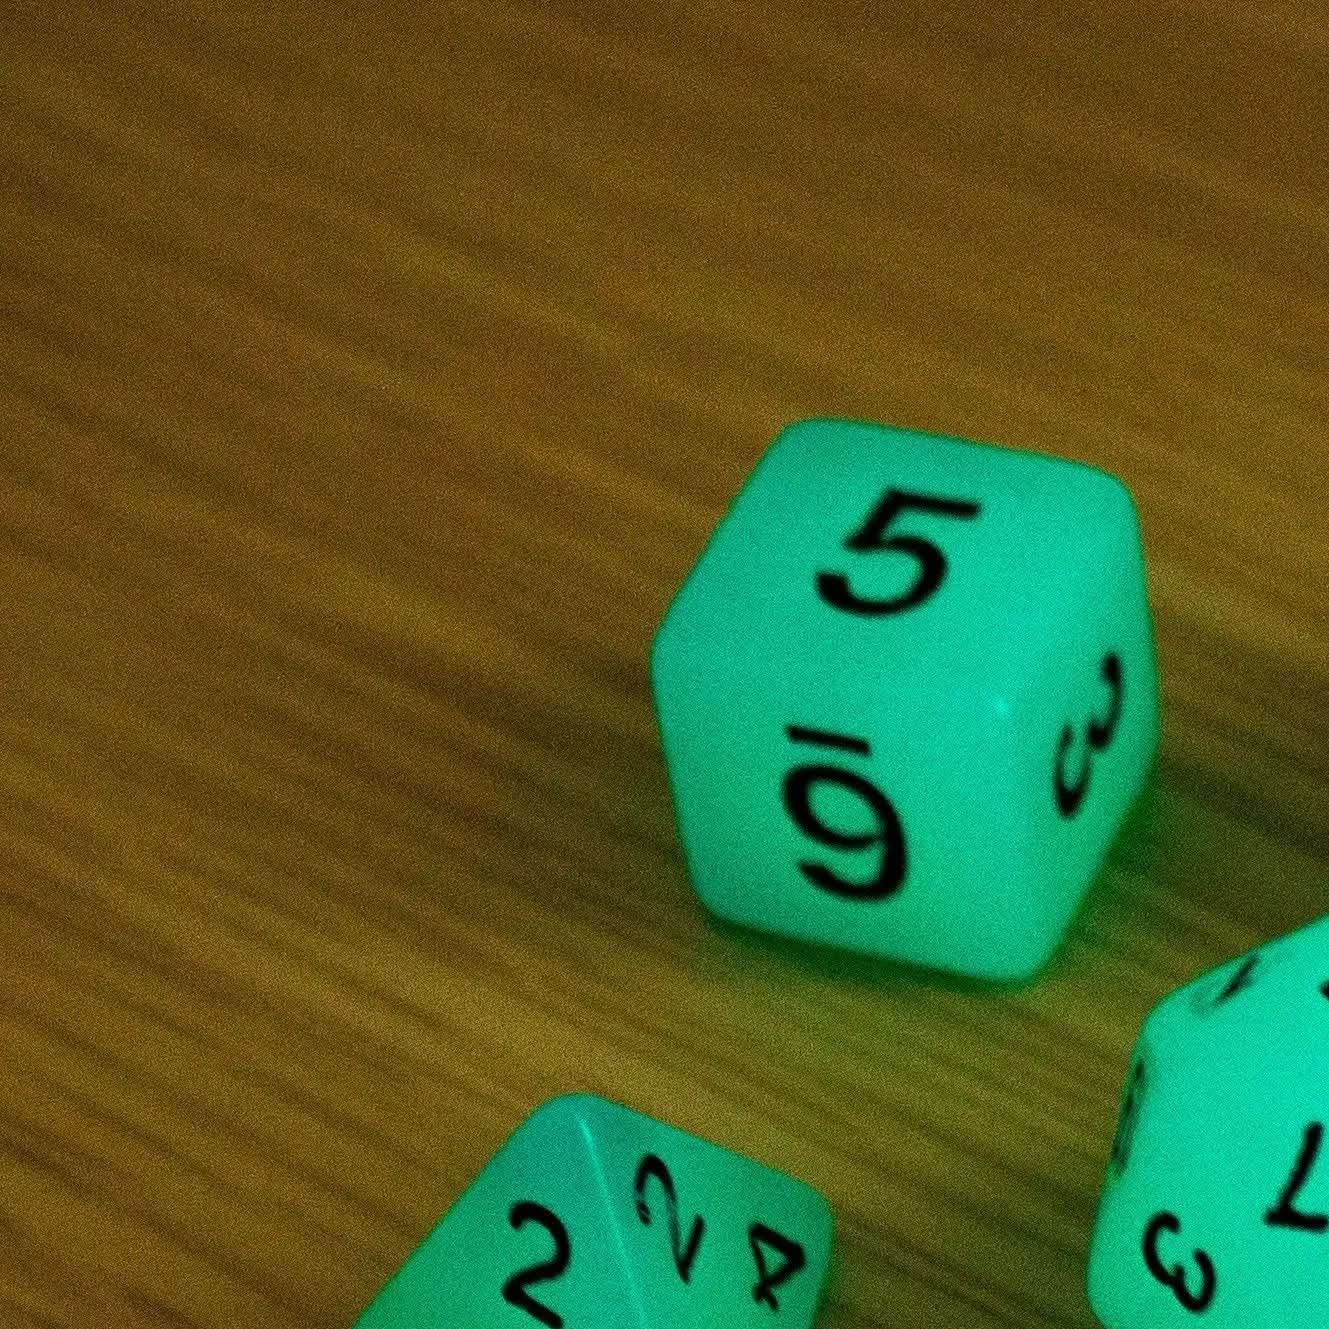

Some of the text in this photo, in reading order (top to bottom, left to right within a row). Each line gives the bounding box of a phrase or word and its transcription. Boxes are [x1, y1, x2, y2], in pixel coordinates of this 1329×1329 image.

[815, 487, 981, 618] 5
[1053, 652, 1123, 821] 3
[634, 1153, 705, 1283] 2
[748, 1222, 807, 1311] 4
[1142, 1211, 1217, 1314] 3
